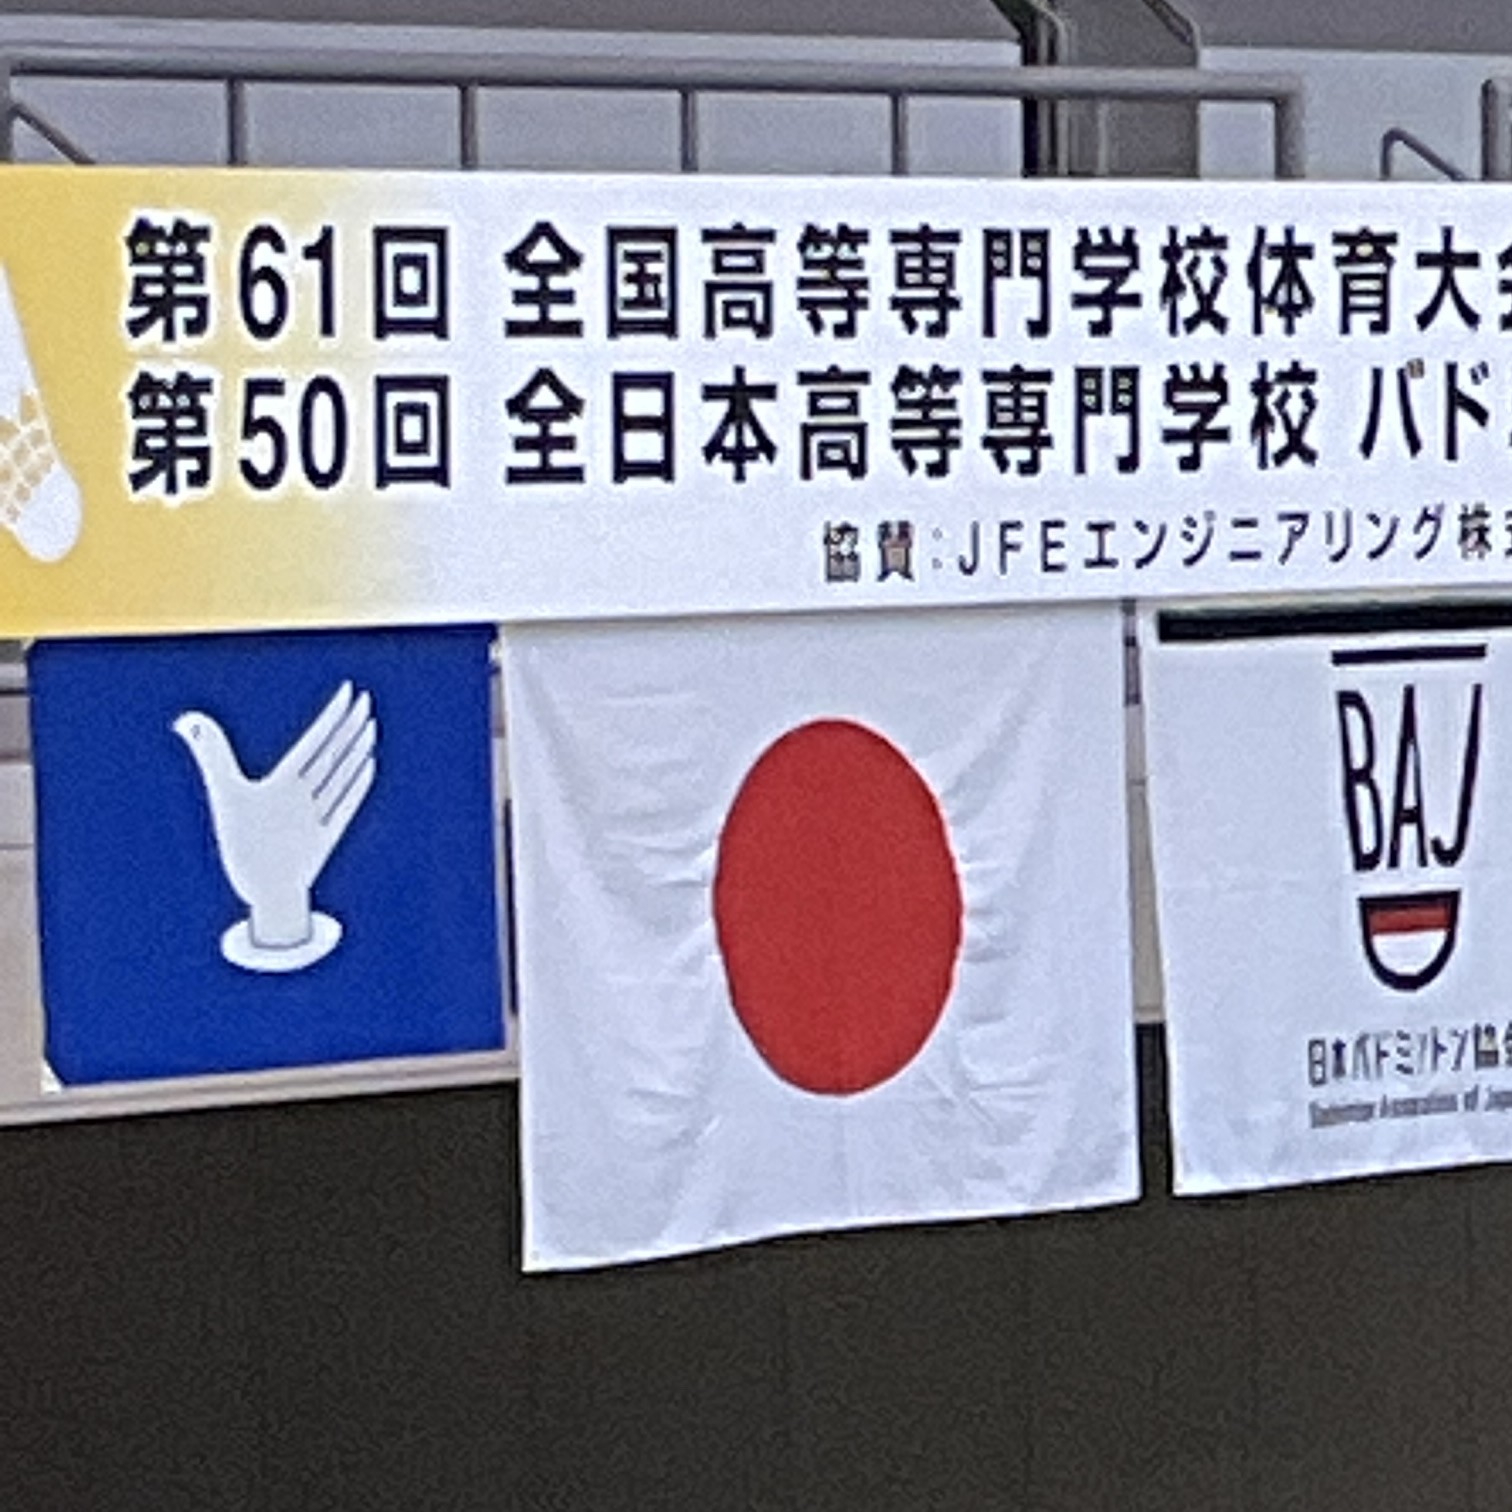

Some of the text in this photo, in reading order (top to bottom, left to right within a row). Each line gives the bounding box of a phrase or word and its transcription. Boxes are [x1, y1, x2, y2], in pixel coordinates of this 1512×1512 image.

[126, 218, 449, 342] 第61回
[128, 372, 450, 494] 第50回
[505, 361, 1317, 484] 全日本高等専門学校
[1336, 683, 1482, 872] BAJ
